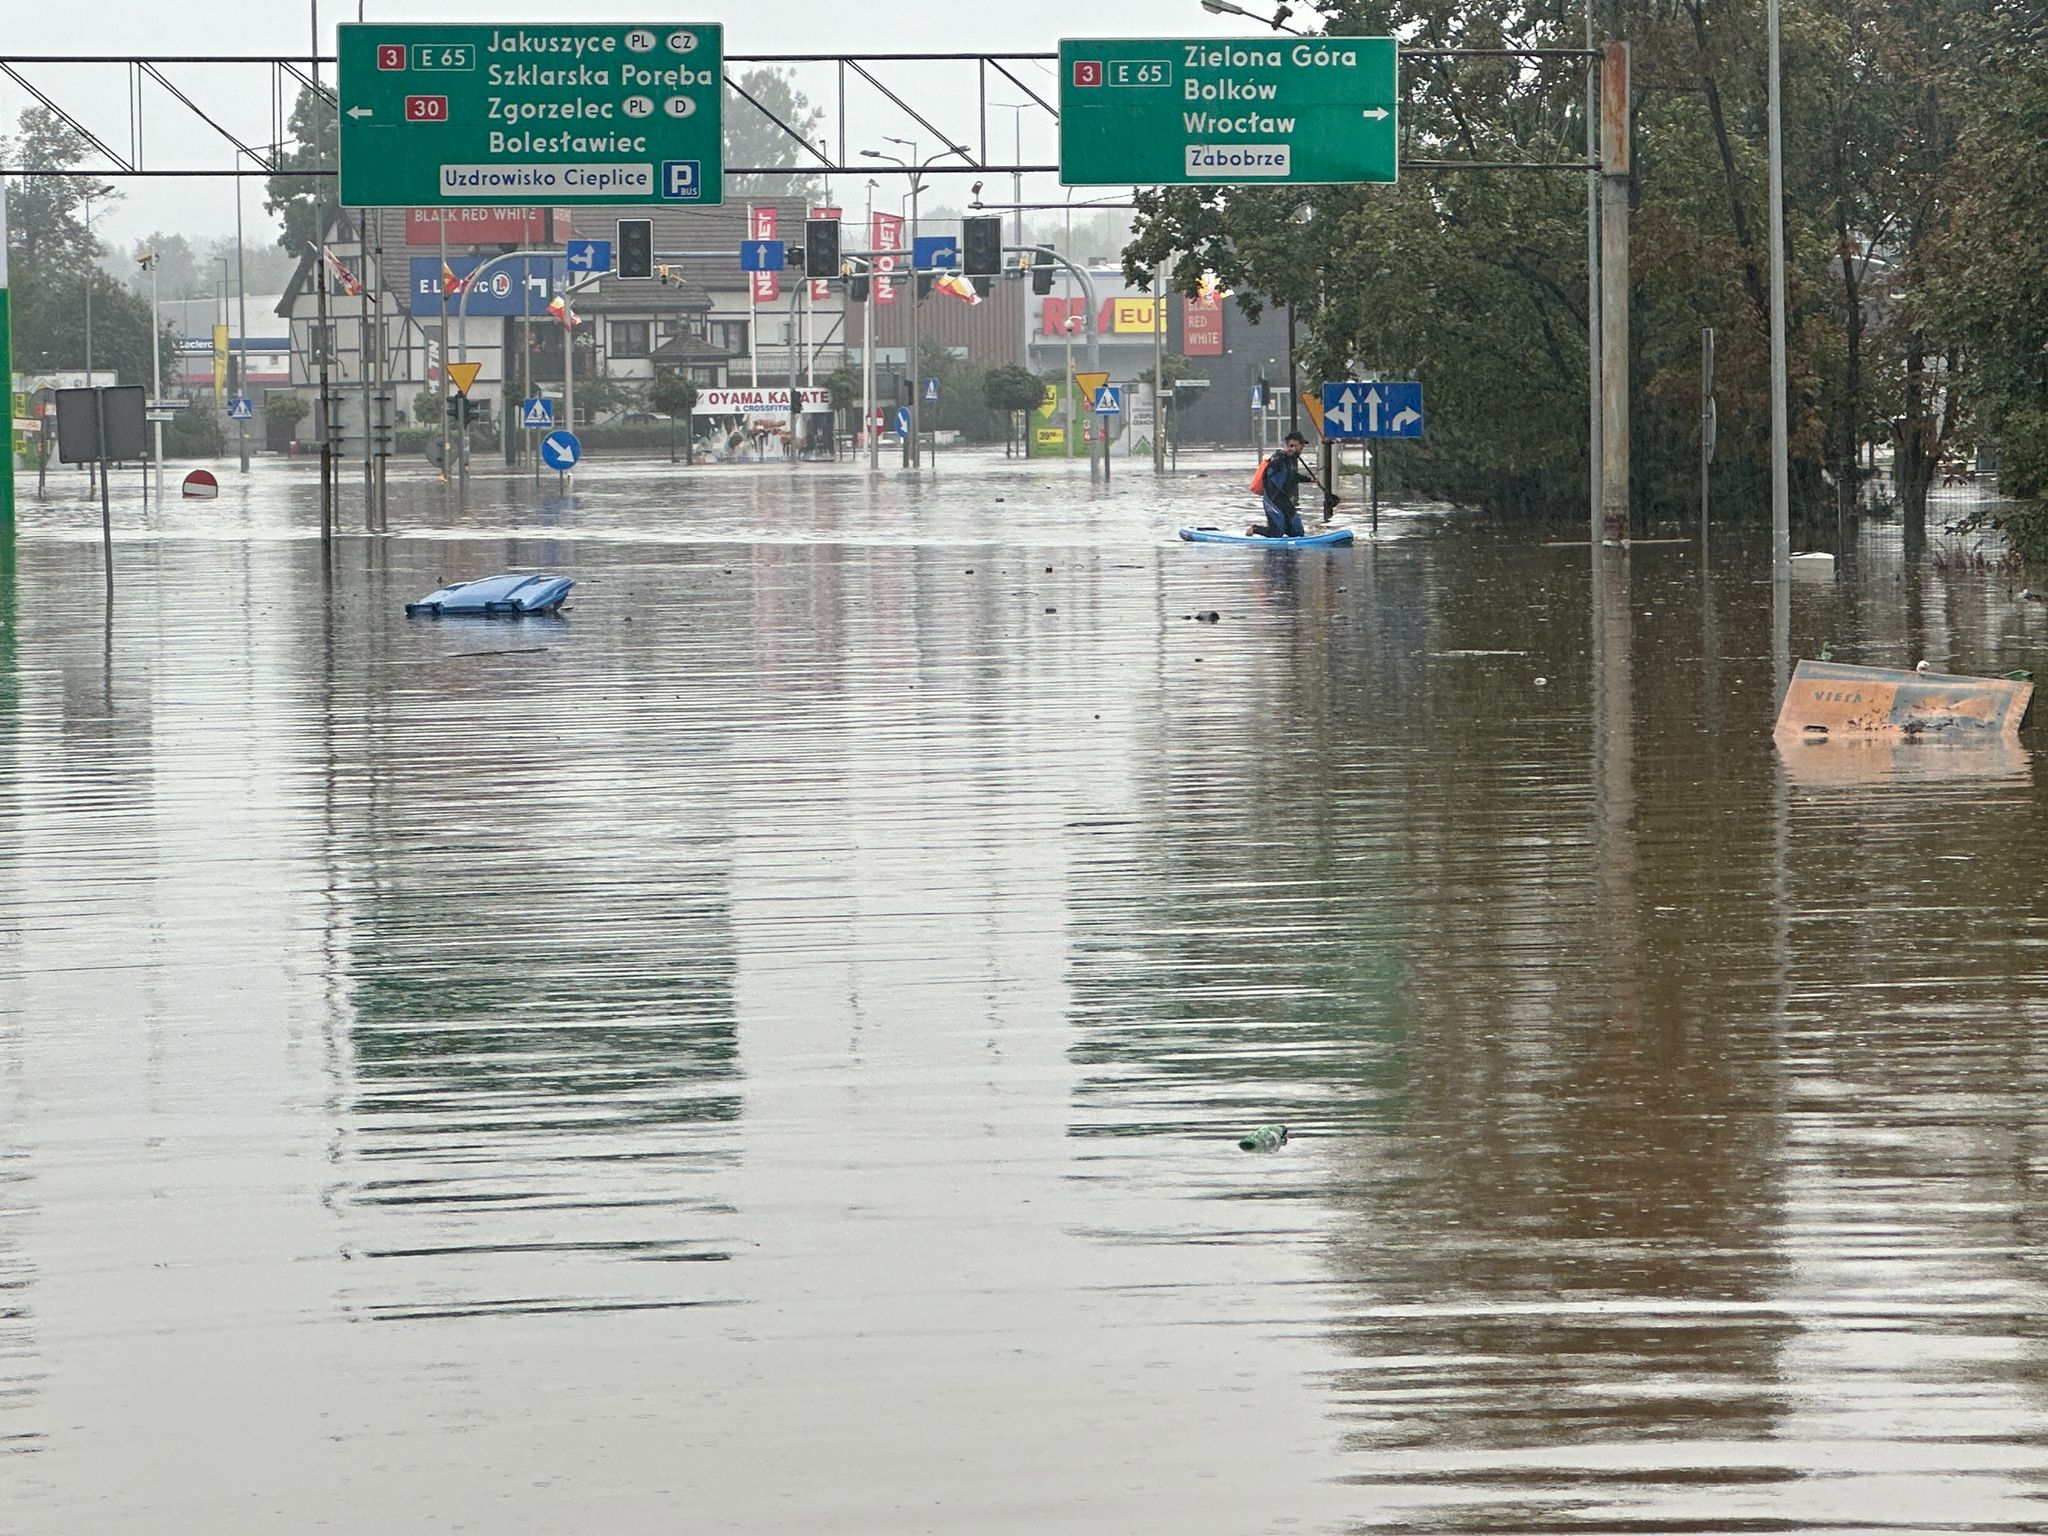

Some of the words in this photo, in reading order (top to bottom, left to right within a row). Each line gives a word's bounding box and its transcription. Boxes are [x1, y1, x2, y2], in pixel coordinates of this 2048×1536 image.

[487, 31, 617, 58] Jakuszyce
[631, 34, 649, 48] PL
[671, 35, 692, 49] CZ
[385, 50, 398, 66] 3
[422, 49, 433, 66] E
[441, 49, 466, 66] 65
[1184, 45, 1282, 68] Zielona
[1291, 44, 1358, 67] Góra
[488, 63, 609, 87] Szklarska
[621, 64, 713, 90] Poręba
[1082, 66, 1094, 82] 3
[1118, 66, 1129, 82] E
[1137, 66, 1163, 82] 65
[1184, 78, 1277, 100] Bolków
[414, 100, 439, 116] 30
[488, 97, 613, 125] Zgorzelec
[629, 100, 647, 114] PL
[675, 100, 687, 113] D
[1183, 111, 1296, 133] Wrocław
[489, 131, 646, 153] Bolesławiec
[1191, 149, 1285, 166] Zabobrze
[445, 169, 556, 187] Uzdrowisko
[565, 169, 648, 190] Cieplice
[671, 165, 693, 193] P
[680, 187, 698, 196] BUS
[415, 208, 457, 222] BLACK
[462, 208, 488, 221] RED
[493, 207, 536, 221] WHITE
[1188, 315, 1207, 328] RED
[1188, 332, 1219, 345] WHITE
[708, 391, 761, 405] OYAMA
[768, 391, 829, 404] KAATE
